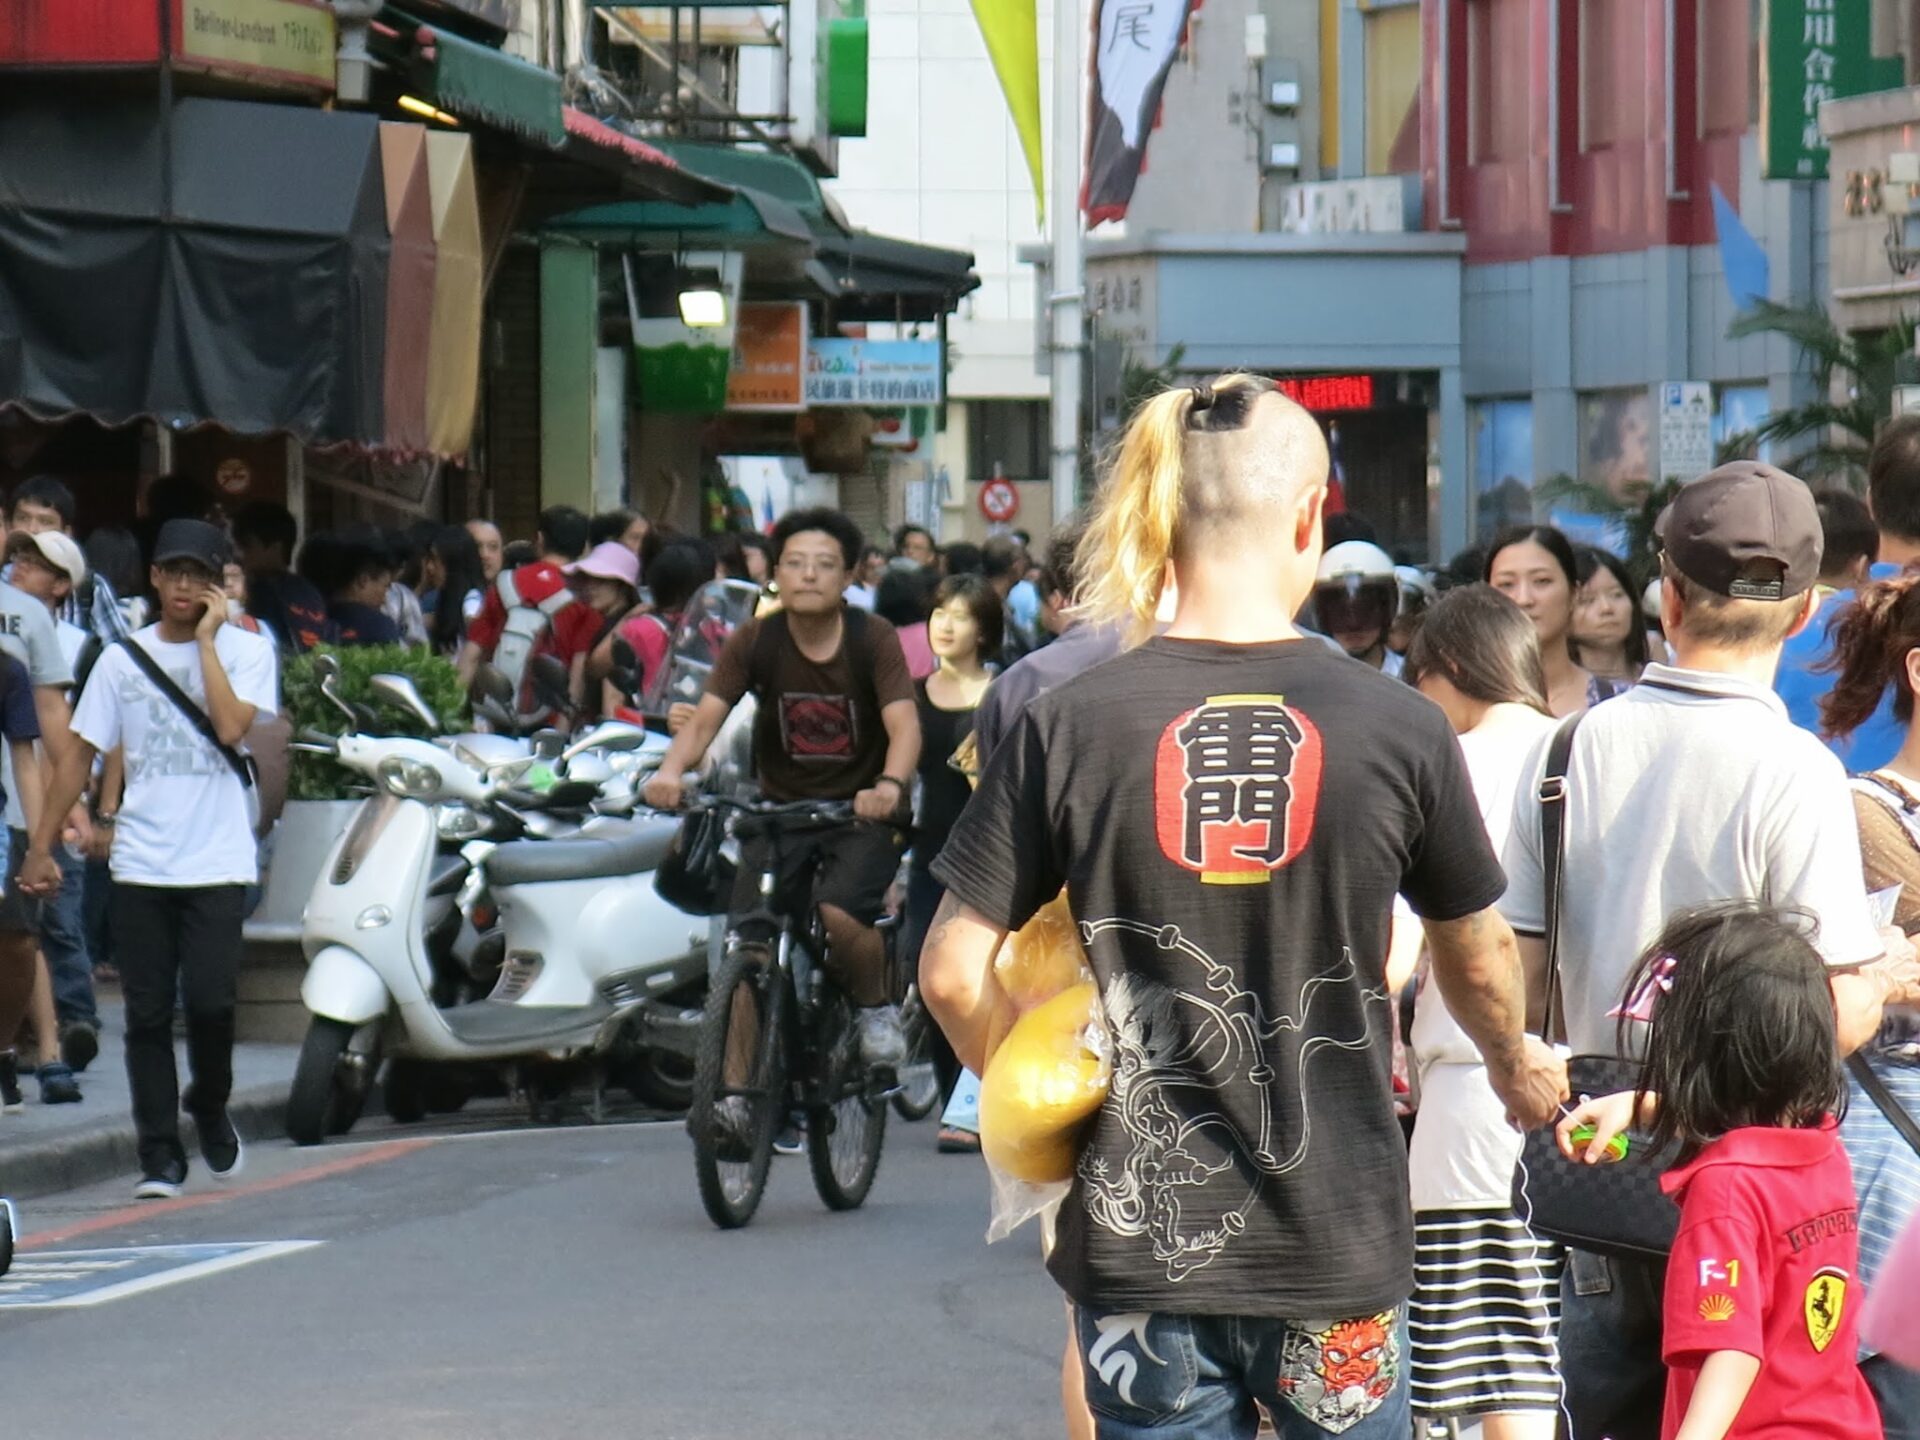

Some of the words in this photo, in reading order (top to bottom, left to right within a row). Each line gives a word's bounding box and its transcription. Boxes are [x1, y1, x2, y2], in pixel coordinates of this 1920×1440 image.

[1108, 4, 1153, 53] 尾
[1803, 0, 1836, 149] 用合作社
[1175, 703, 1305, 867] 雷門
[1699, 1259, 1740, 1287] F-1
